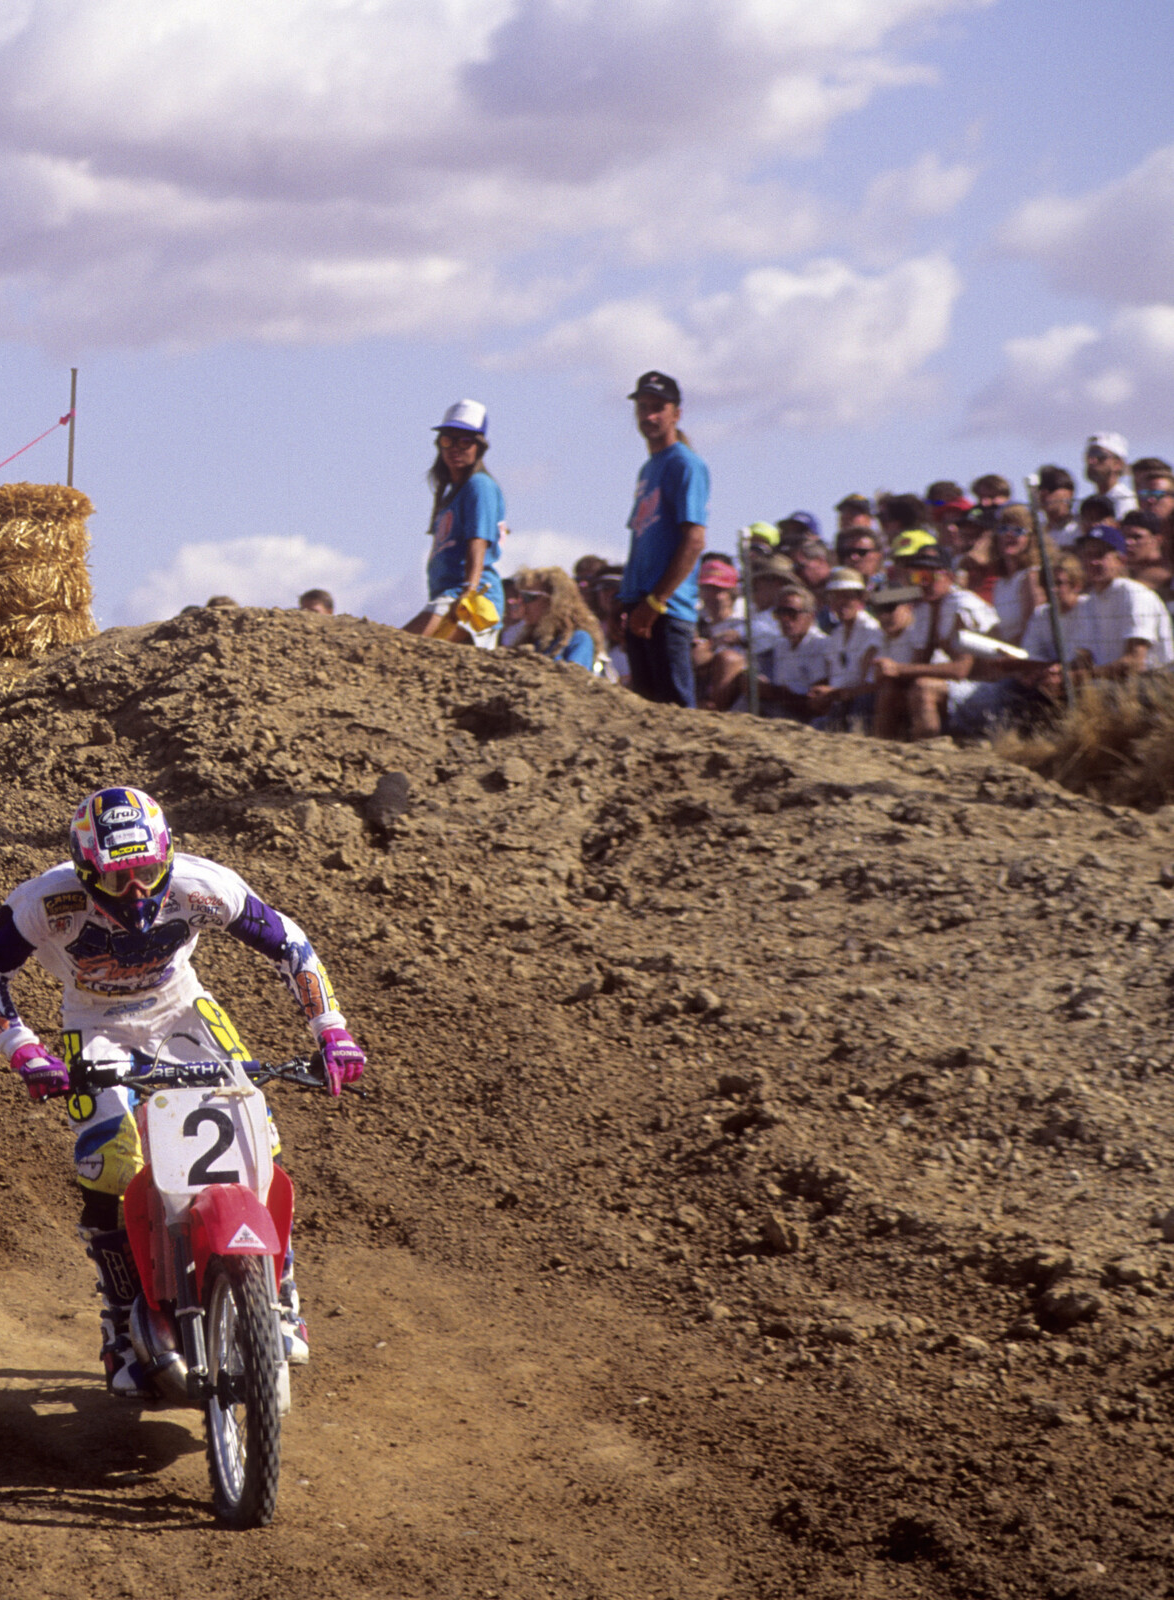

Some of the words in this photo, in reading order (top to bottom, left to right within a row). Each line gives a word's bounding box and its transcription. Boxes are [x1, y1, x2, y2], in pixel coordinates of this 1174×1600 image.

[109, 809, 135, 820] Arai
[110, 844, 147, 858] SCOTT
[187, 890, 225, 906] Coors
[191, 904, 220, 916] LIGHT
[331, 1049, 364, 1058] HONDA
[151, 1063, 229, 1078] RENTHA
[182, 1106, 241, 1187] 2
